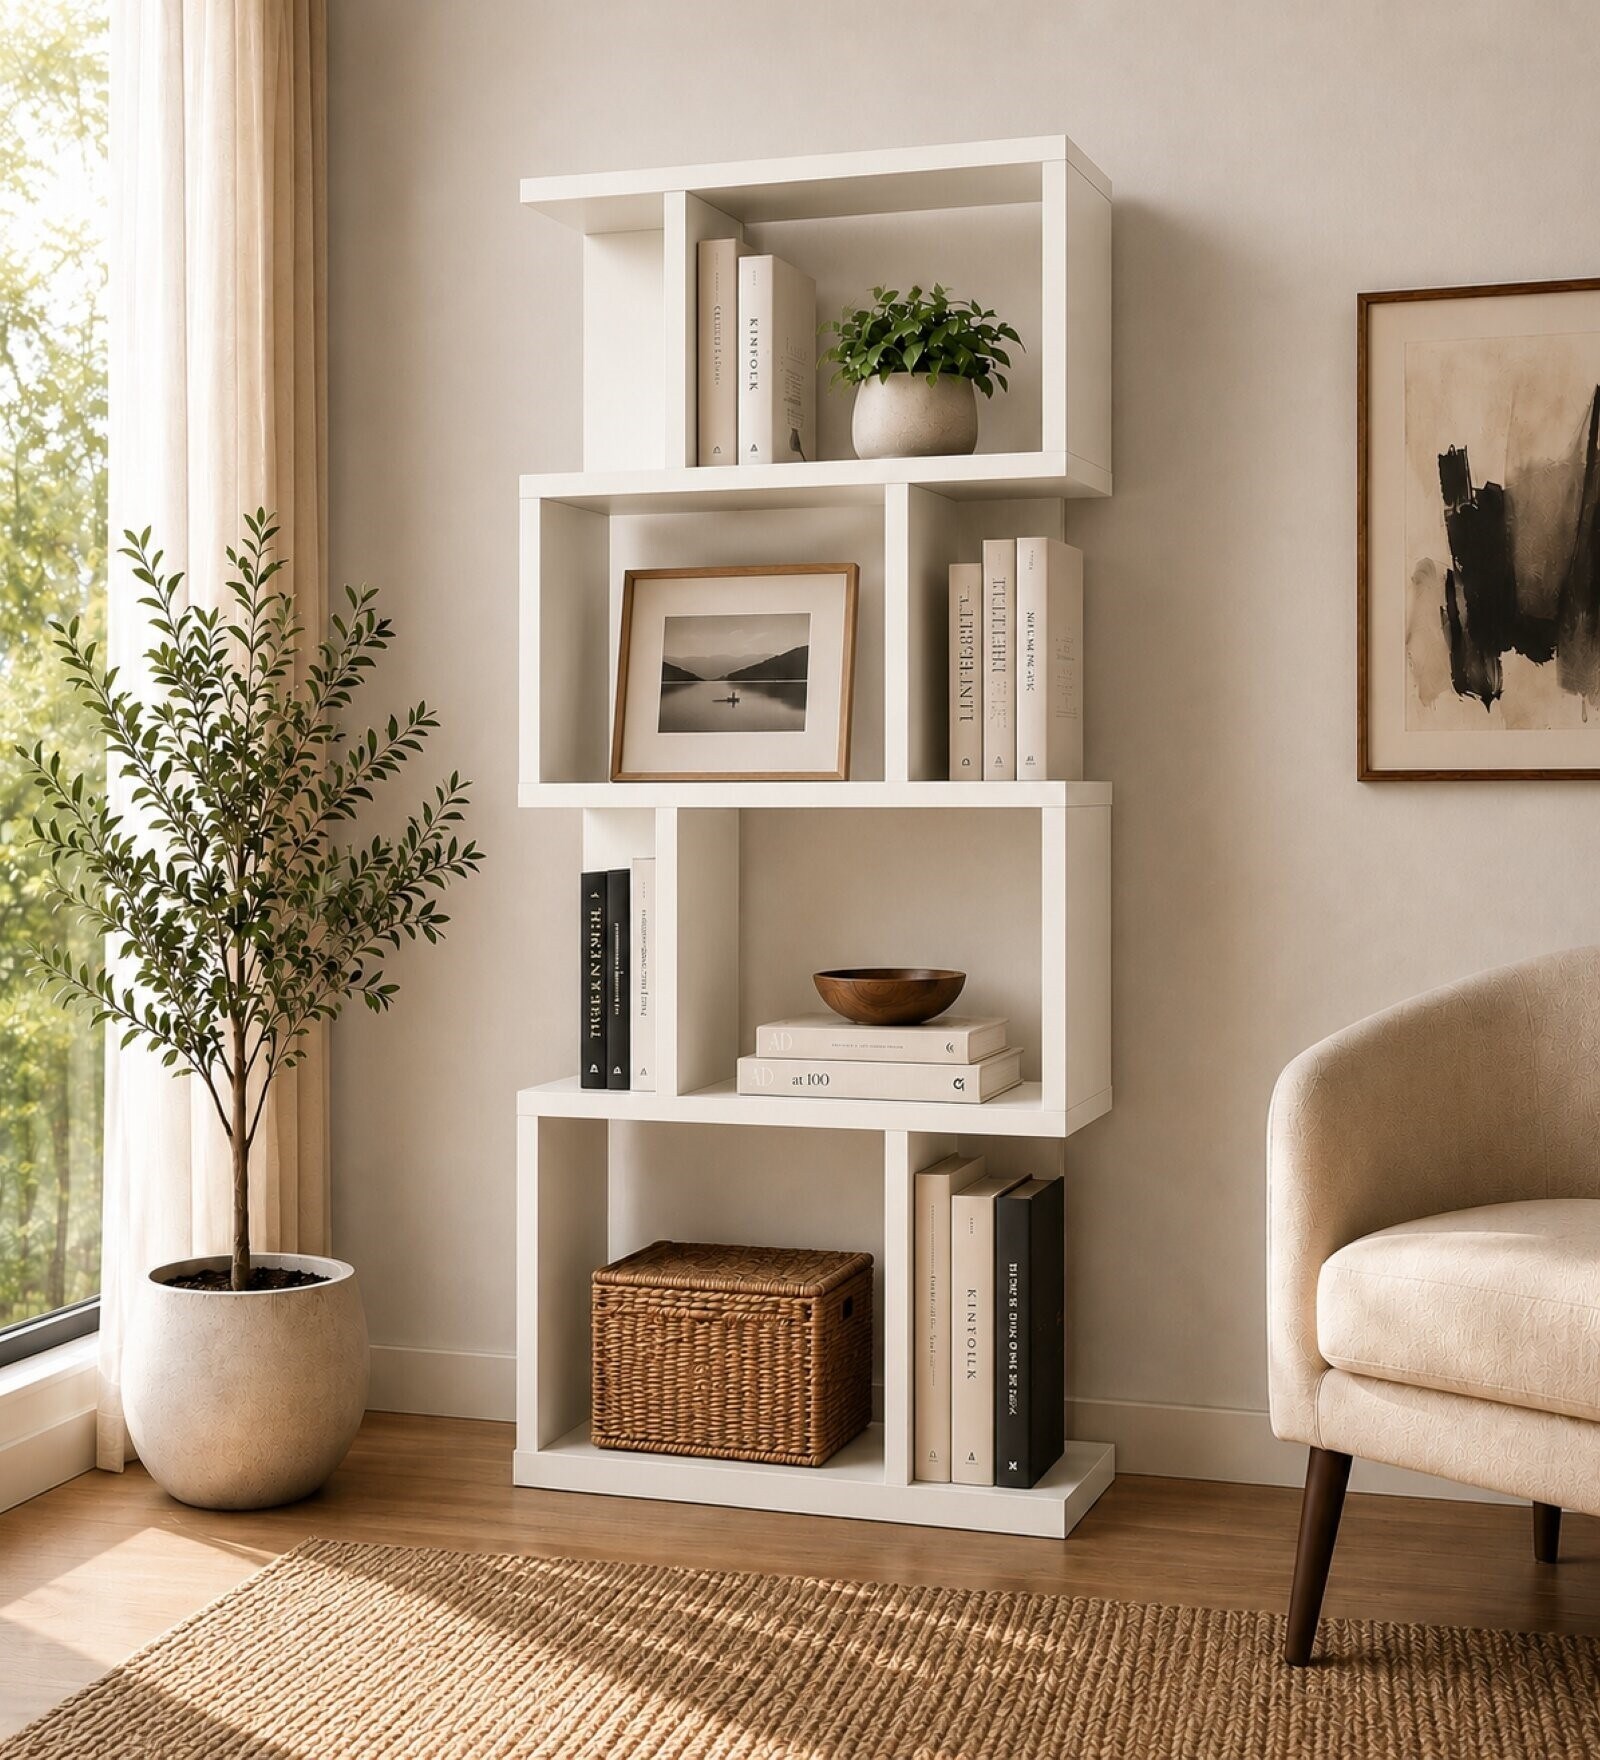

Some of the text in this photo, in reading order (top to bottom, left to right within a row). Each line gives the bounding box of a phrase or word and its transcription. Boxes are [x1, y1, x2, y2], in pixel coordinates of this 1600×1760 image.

[749, 317, 759, 391] KINFOLK
[768, 1032, 793, 1052] AD
[792, 1075, 804, 1086] at
[807, 1073, 830, 1086] 100
